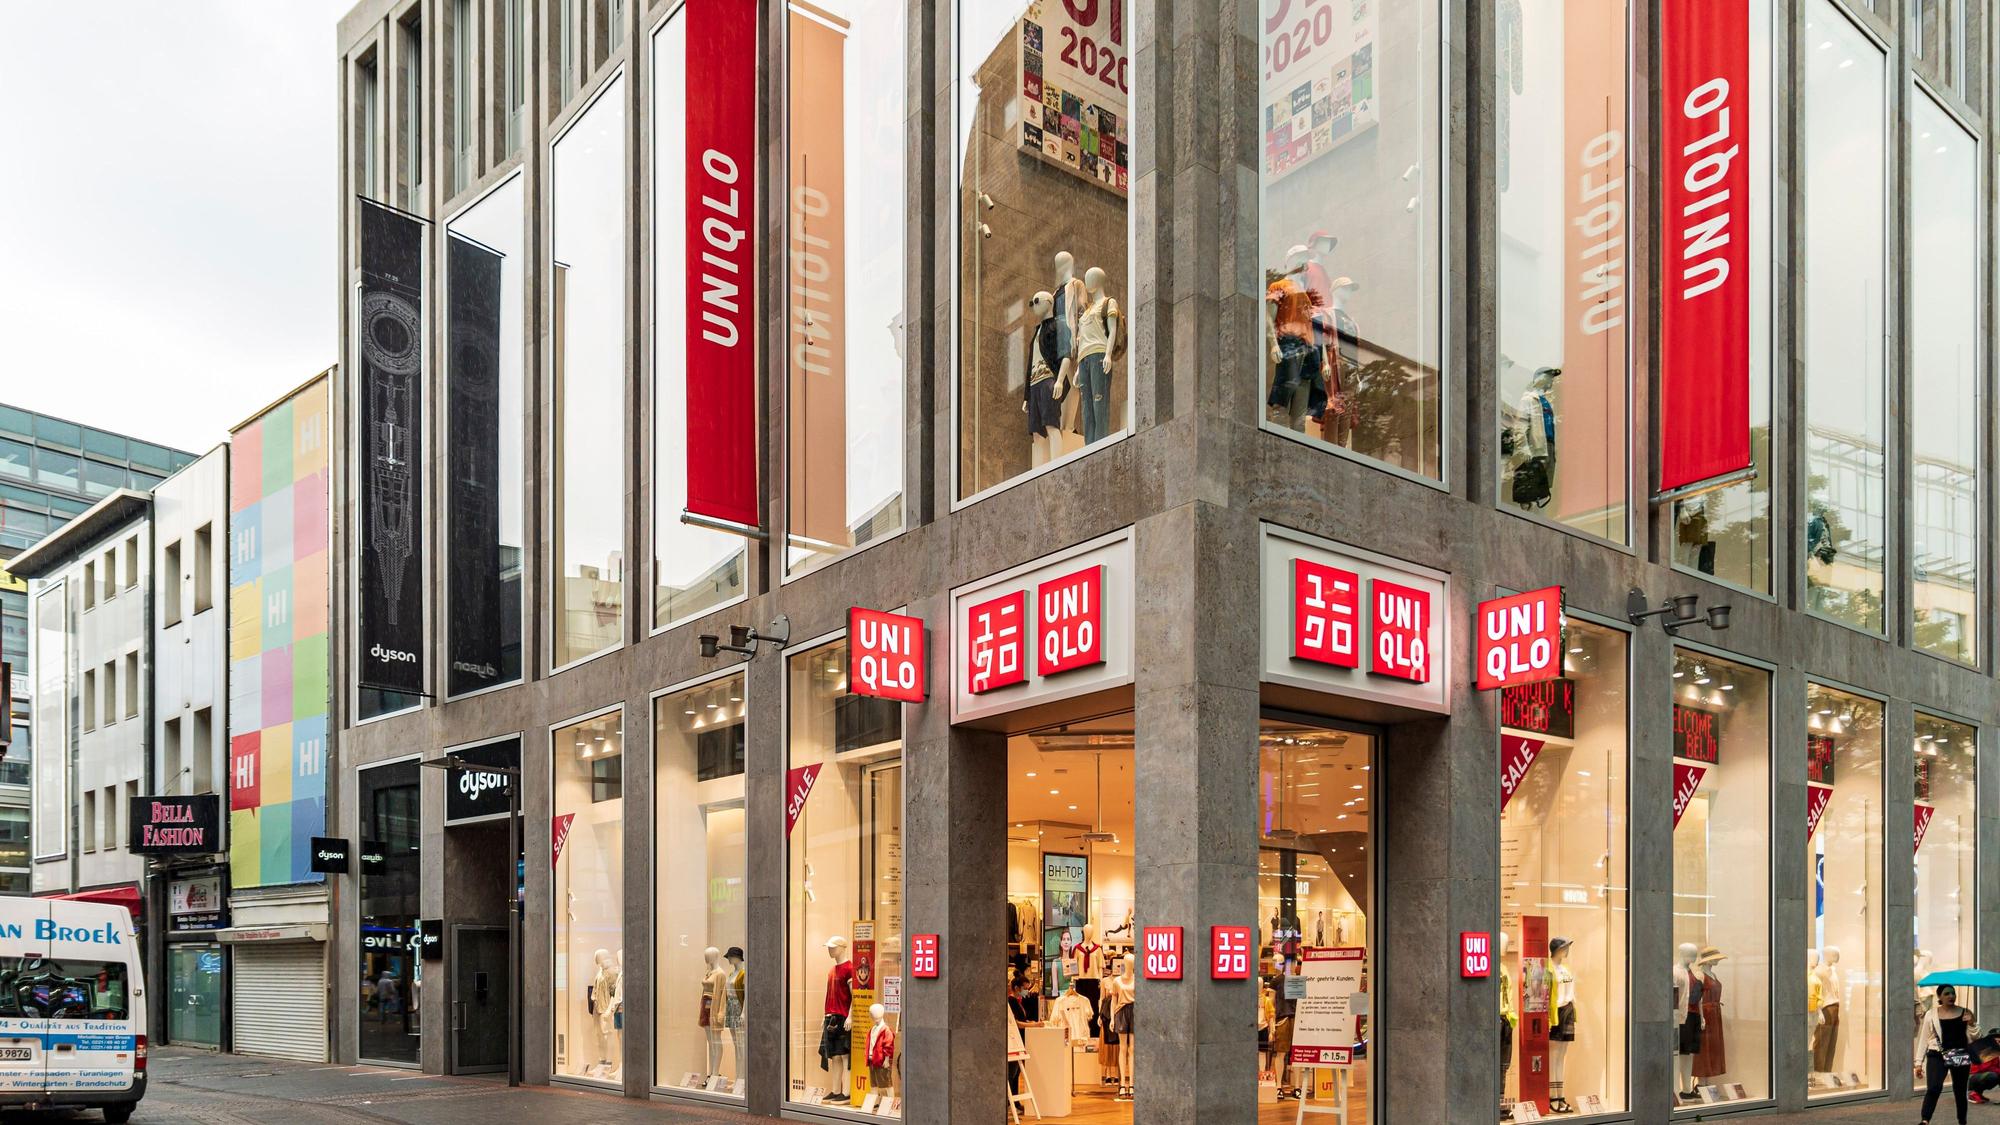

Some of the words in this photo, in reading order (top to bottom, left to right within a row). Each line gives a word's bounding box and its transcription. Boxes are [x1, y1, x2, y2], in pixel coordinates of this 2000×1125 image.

[1684, 77, 1738, 300] UNIQLO
[702, 149, 745, 348] UNIQLO
[300, 412, 321, 455] HI
[237, 526, 256, 564] HI
[268, 590, 287, 628] HI
[1044, 581, 1089, 624] UNI
[1379, 592, 1421, 632] UNI
[1487, 600, 1545, 641] UNI
[370, 644, 416, 662] dyson
[860, 619, 910, 656] UNI
[1044, 620, 1093, 666] QLO
[1379, 632, 1425, 670] QLO
[860, 655, 916, 690] QLO
[1487, 637, 1551, 682] QLO
[236, 753, 254, 790] HI
[300, 738, 320, 777] HI
[1501, 740, 1534, 795] SALE
[460, 770, 508, 801] dyson
[788, 768, 815, 821] SALE
[1673, 768, 1699, 816] SALE
[151, 802, 194, 823] BELLA
[1808, 790, 1827, 832] SALE
[1914, 808, 1930, 846] SALE
[142, 824, 204, 847] FASHION
[552, 818, 571, 856] SALE
[318, 850, 344, 860] dyson
[1048, 864, 1083, 878] BH-TOP
[423, 934, 438, 944] dyson
[1147, 933, 1174, 952] UNI
[1466, 938, 1486, 954] UNI
[1148, 954, 1177, 975] QLO
[1466, 956, 1488, 974] QLO
[5, 1050, 30, 1058] 9876
[856, 1076, 867, 1091] UT
